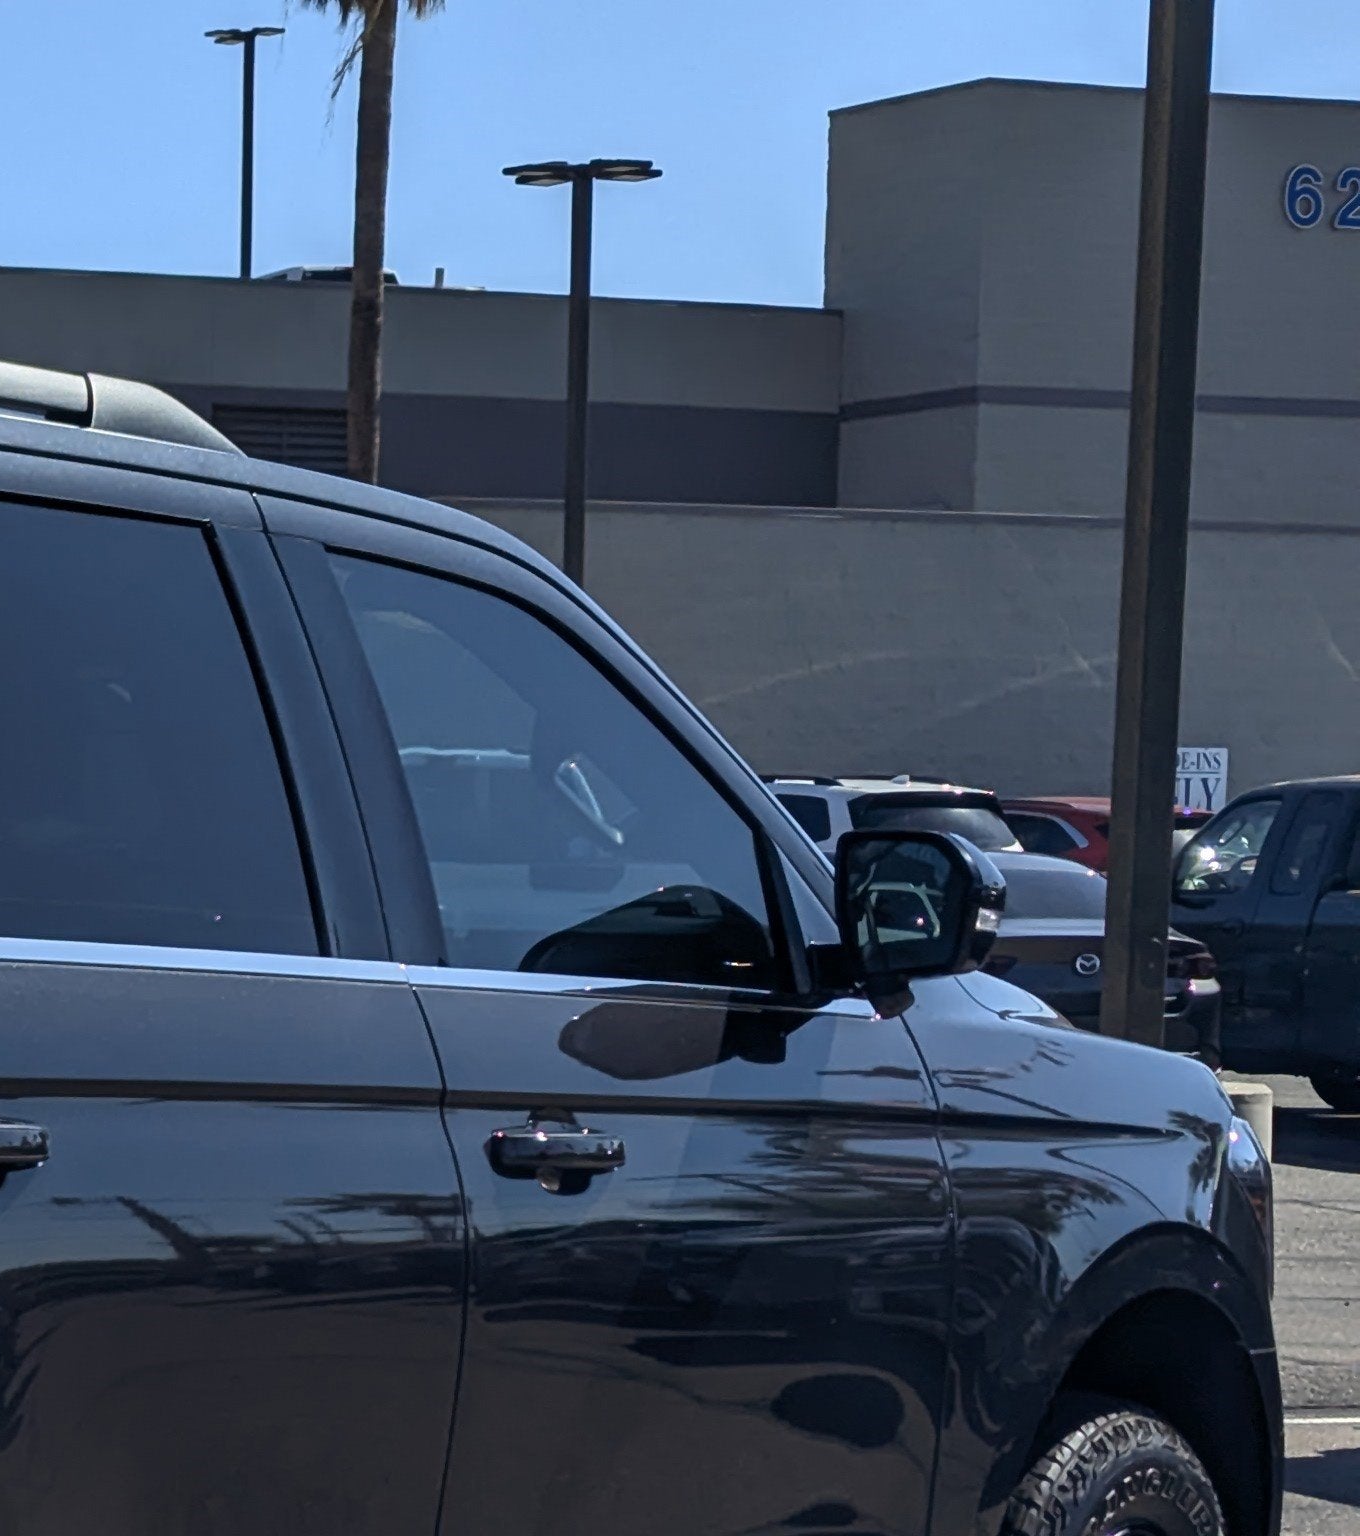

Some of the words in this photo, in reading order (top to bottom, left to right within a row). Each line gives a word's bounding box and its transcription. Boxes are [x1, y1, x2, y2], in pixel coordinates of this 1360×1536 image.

[1285, 163, 1360, 229] 62
[1176, 752, 1222, 770] E-INS
[1175, 777, 1222, 811] LY
